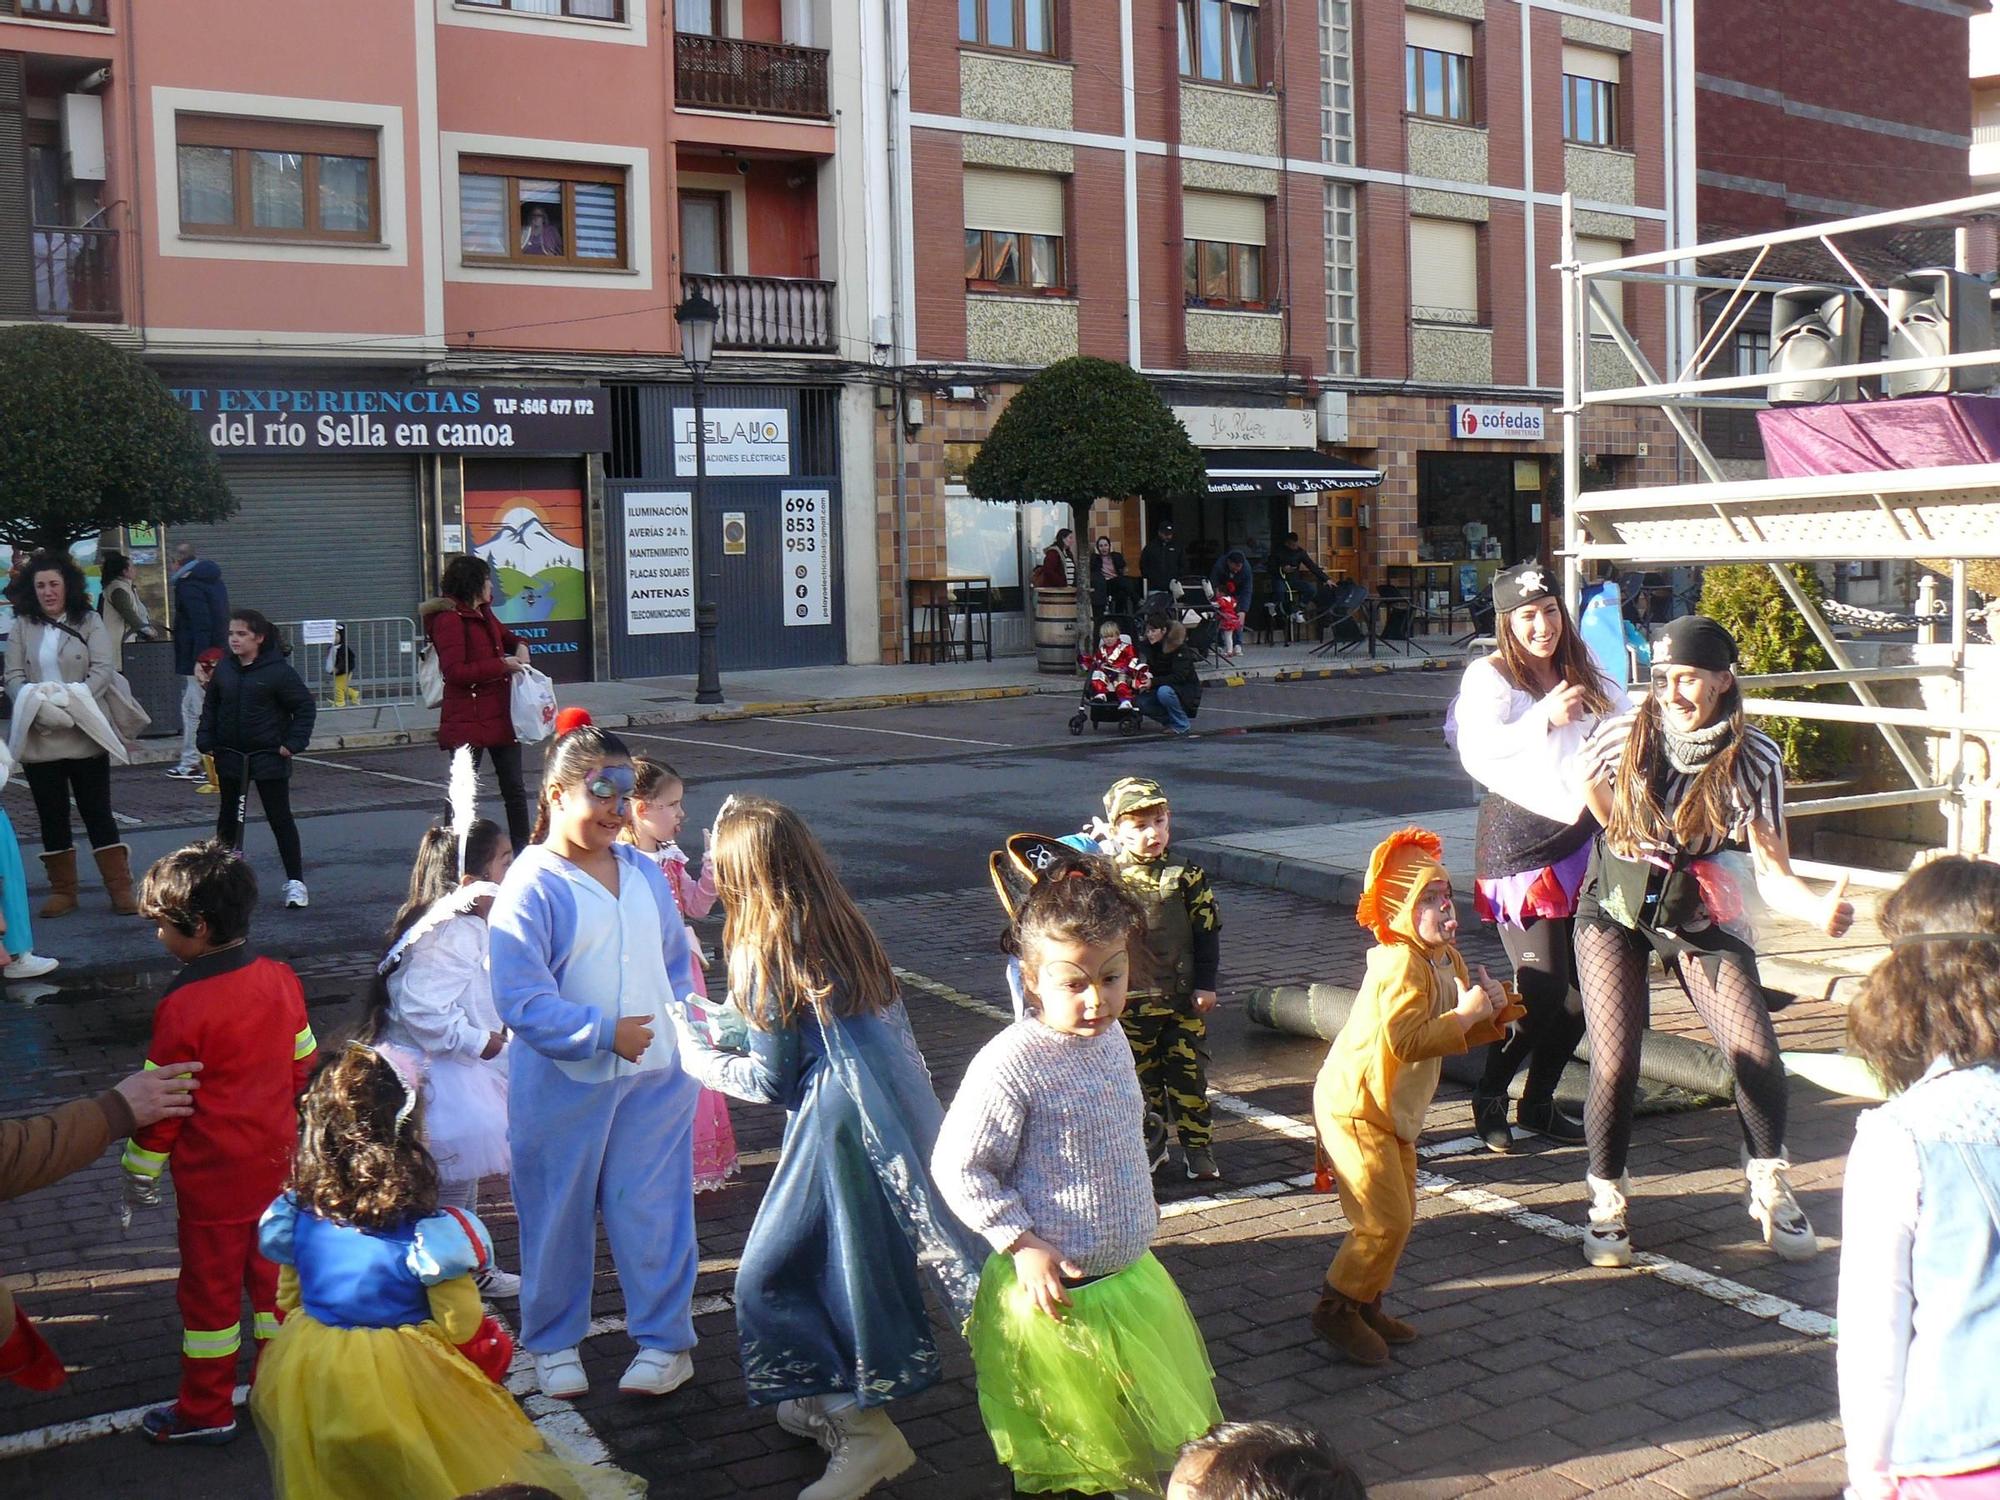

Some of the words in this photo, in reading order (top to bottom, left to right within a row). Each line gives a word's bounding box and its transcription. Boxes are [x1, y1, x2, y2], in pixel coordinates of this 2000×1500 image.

[216, 389, 481, 413] EXPERIENCIAS
[494, 398, 517, 414] TLF
[550, 399, 572, 415] 477
[574, 399, 594, 415] 172
[1482, 411, 1540, 429] cofedas
[210, 412, 257, 446] del
[264, 411, 306, 446] río
[317, 414, 388, 446] Sella
[395, 422, 429, 446] en
[436, 422, 515, 446] canoa
[628, 504, 689, 517] ILUMINACIÓN
[785, 498, 815, 512] 696
[629, 526, 664, 537] AVERÍAS
[667, 527, 678, 536] 24
[786, 518, 815, 532] 853
[786, 537, 815, 552] 953
[629, 547, 689, 558] MANTENIMIENTO
[630, 568, 657, 579] PLACAS
[660, 567, 690, 577] SOLARES
[631, 587, 690, 599] ANTENAS
[631, 608, 691, 620] TELECOMUNICACIONES
